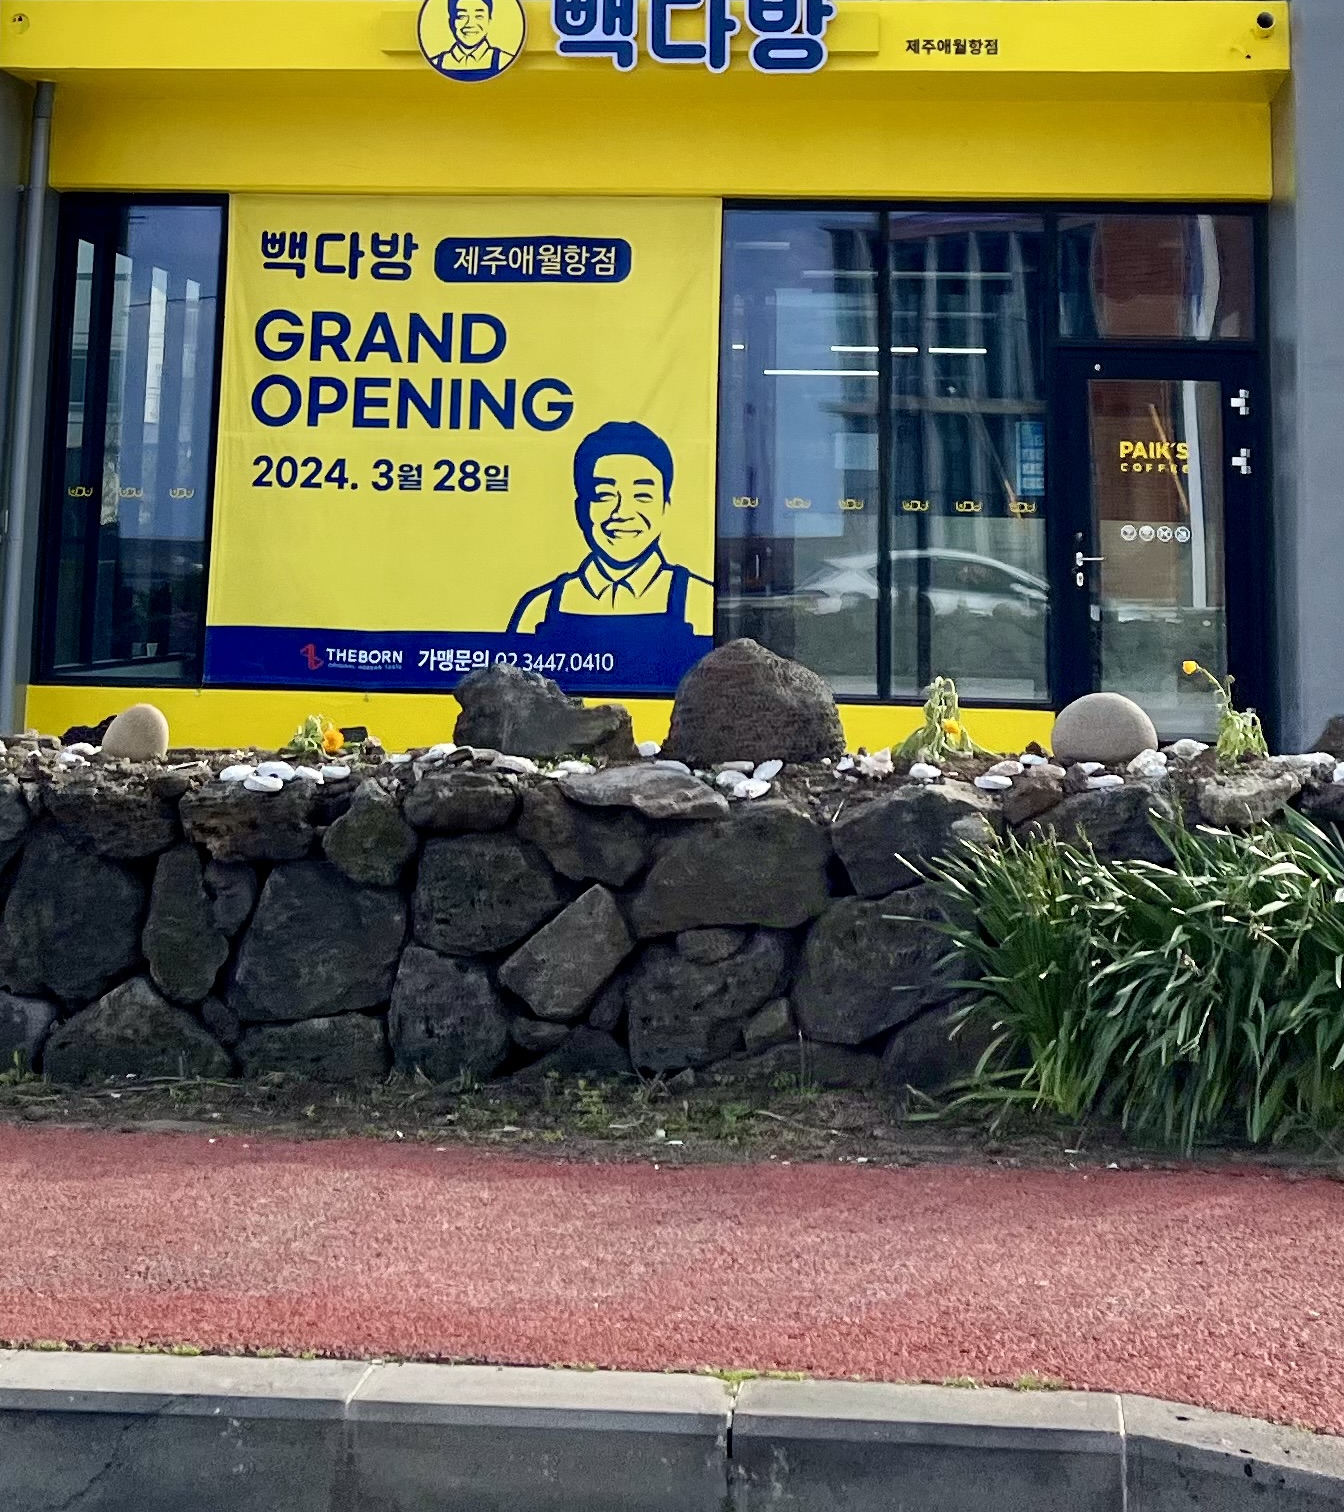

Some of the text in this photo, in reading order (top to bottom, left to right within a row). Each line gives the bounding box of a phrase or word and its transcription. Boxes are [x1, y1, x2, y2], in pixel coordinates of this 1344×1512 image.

[905, 38, 999, 55] 제주애월항점
[261, 230, 419, 281] 빽다방
[453, 242, 617, 277] 제주애월항점
[255, 308, 508, 364] GRAND
[251, 373, 574, 432] OPENING
[1119, 441, 1188, 459] PAIK'S
[252, 455, 510, 493] 2024. 3월 28일
[326, 648, 403, 664] THEBORN
[417, 648, 615, 672] 가맹문의 023447.0410
